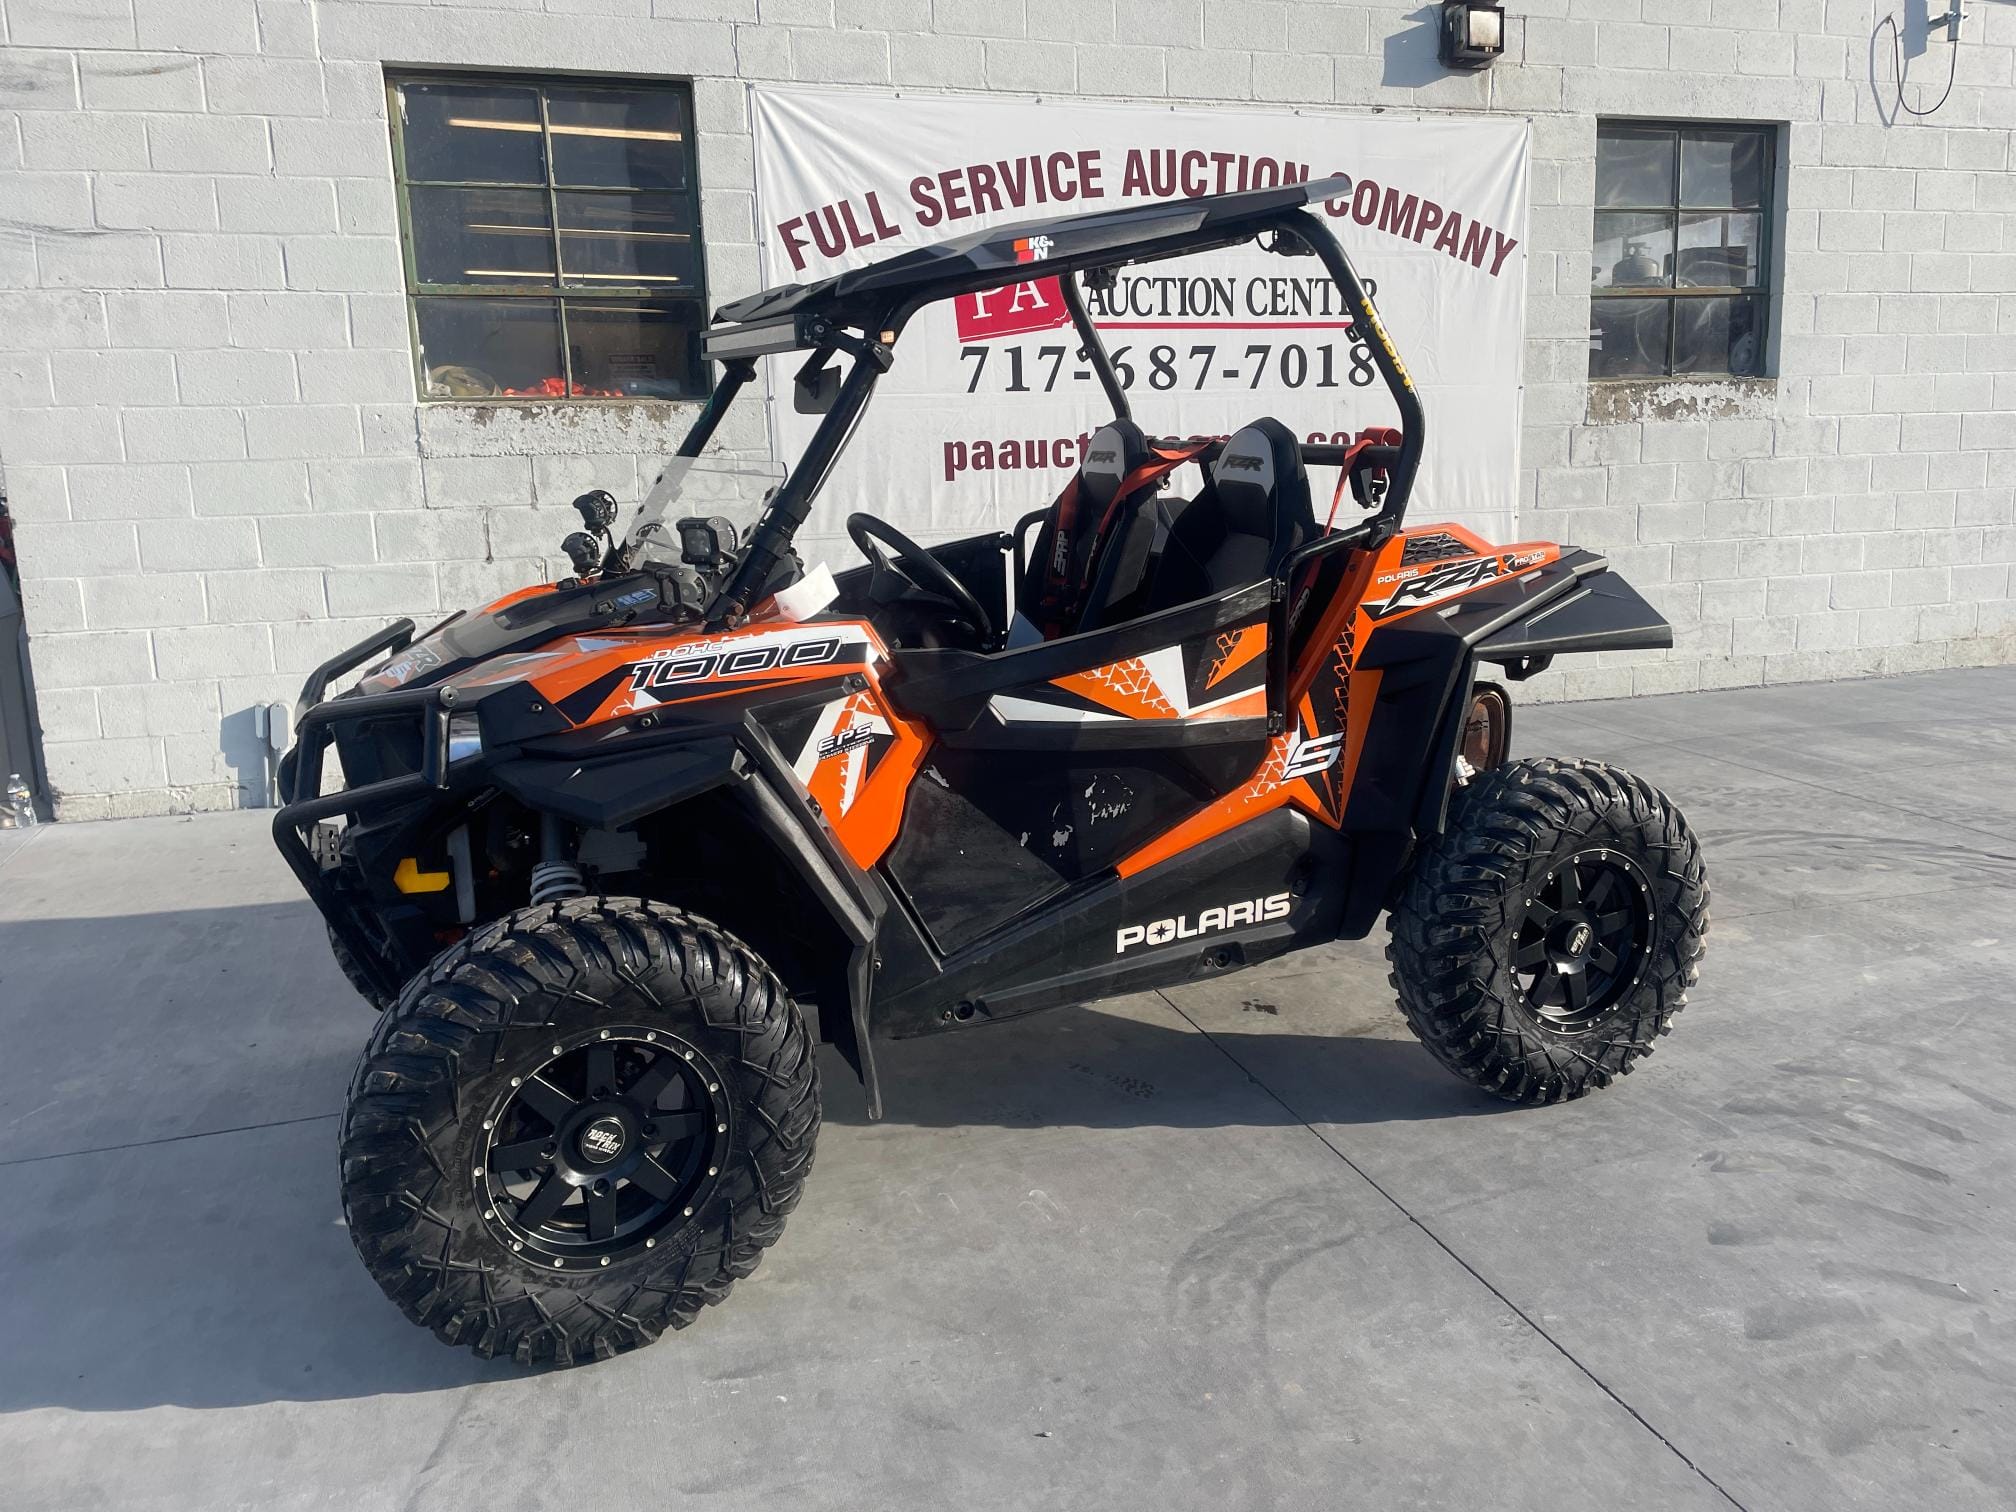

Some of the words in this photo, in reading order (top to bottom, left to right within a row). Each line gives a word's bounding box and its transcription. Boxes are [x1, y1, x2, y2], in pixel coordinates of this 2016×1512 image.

[777, 191, 902, 272] FULL
[909, 150, 1105, 227] SERVICE
[1088, 275, 1236, 317] AUCTION
[959, 343, 1376, 394] 717-687-7018
[1222, 453, 1265, 472] RZR
[1377, 568, 1420, 585] POLARIS
[628, 636, 842, 692] 1000
[652, 641, 725, 661] DOHC
[817, 722, 873, 752] EPS
[1115, 892, 1292, 954] POLARIS
